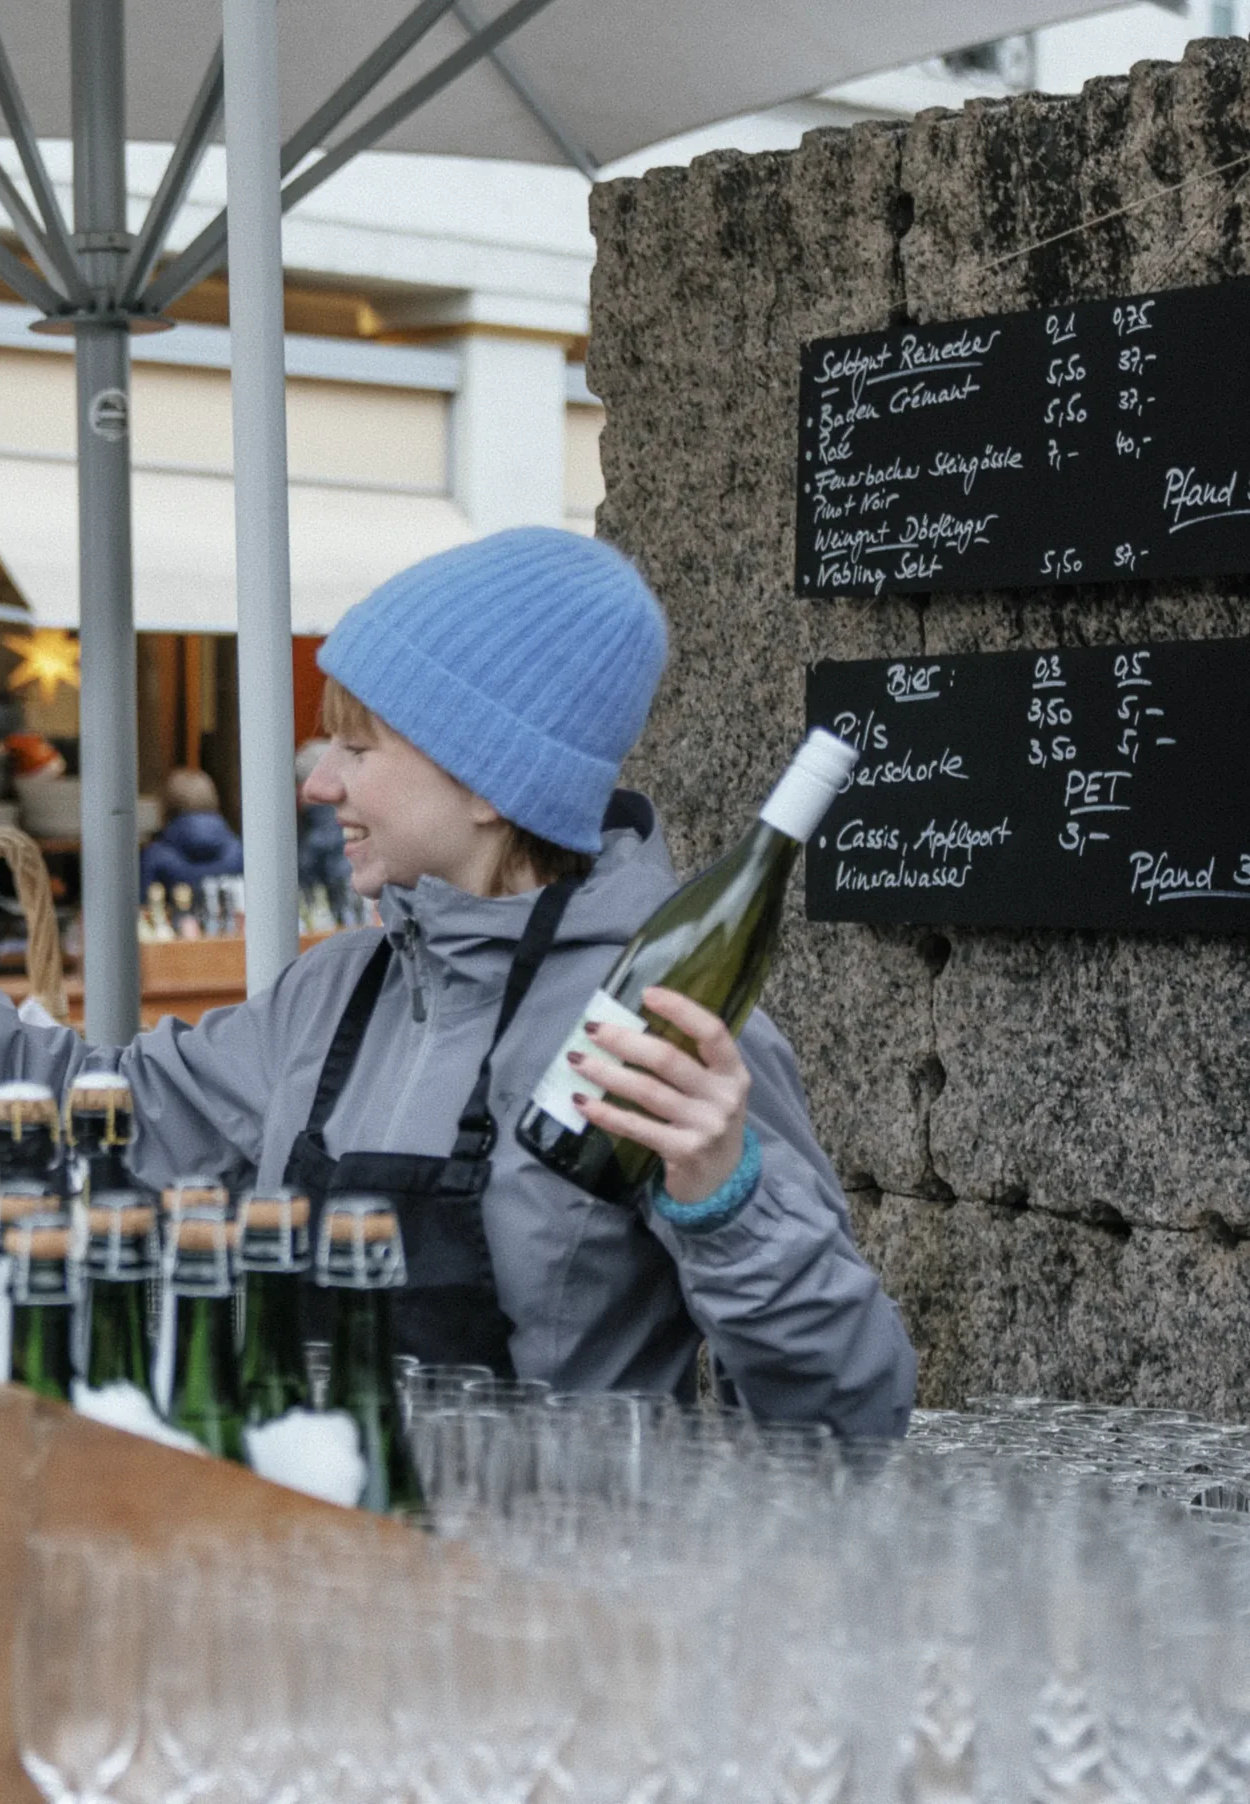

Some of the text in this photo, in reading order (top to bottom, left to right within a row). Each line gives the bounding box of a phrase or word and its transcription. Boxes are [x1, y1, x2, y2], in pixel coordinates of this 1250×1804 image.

[1046, 300, 1155, 344] 0,1 0,75
[1046, 347, 1157, 387] 5,50 37,-
[820, 374, 980, 431] Baden Crémant
[1044, 388, 1156, 428] 5,50 37,-
[819, 426, 855, 465] Rosé
[1116, 431, 1152, 459] 40,-
[813, 488, 899, 524] Pinot Noir
[1163, 467, 1238, 523] Pfand
[814, 521, 890, 563] Weingut
[895, 552, 943, 580] Sekt
[1041, 548, 1082, 579] 5,50
[1035, 651, 1150, 682] 0,3 0,5
[834, 710, 889, 750] Pils
[1028, 695, 1164, 729] 3,50 5,-
[1028, 736, 1076, 768] 3,50
[1064, 770, 1132, 806] PET
[1059, 822, 1110, 856] 3,-
[836, 860, 972, 891] Mineralwasser
[1130, 851, 1215, 905] Pfand
